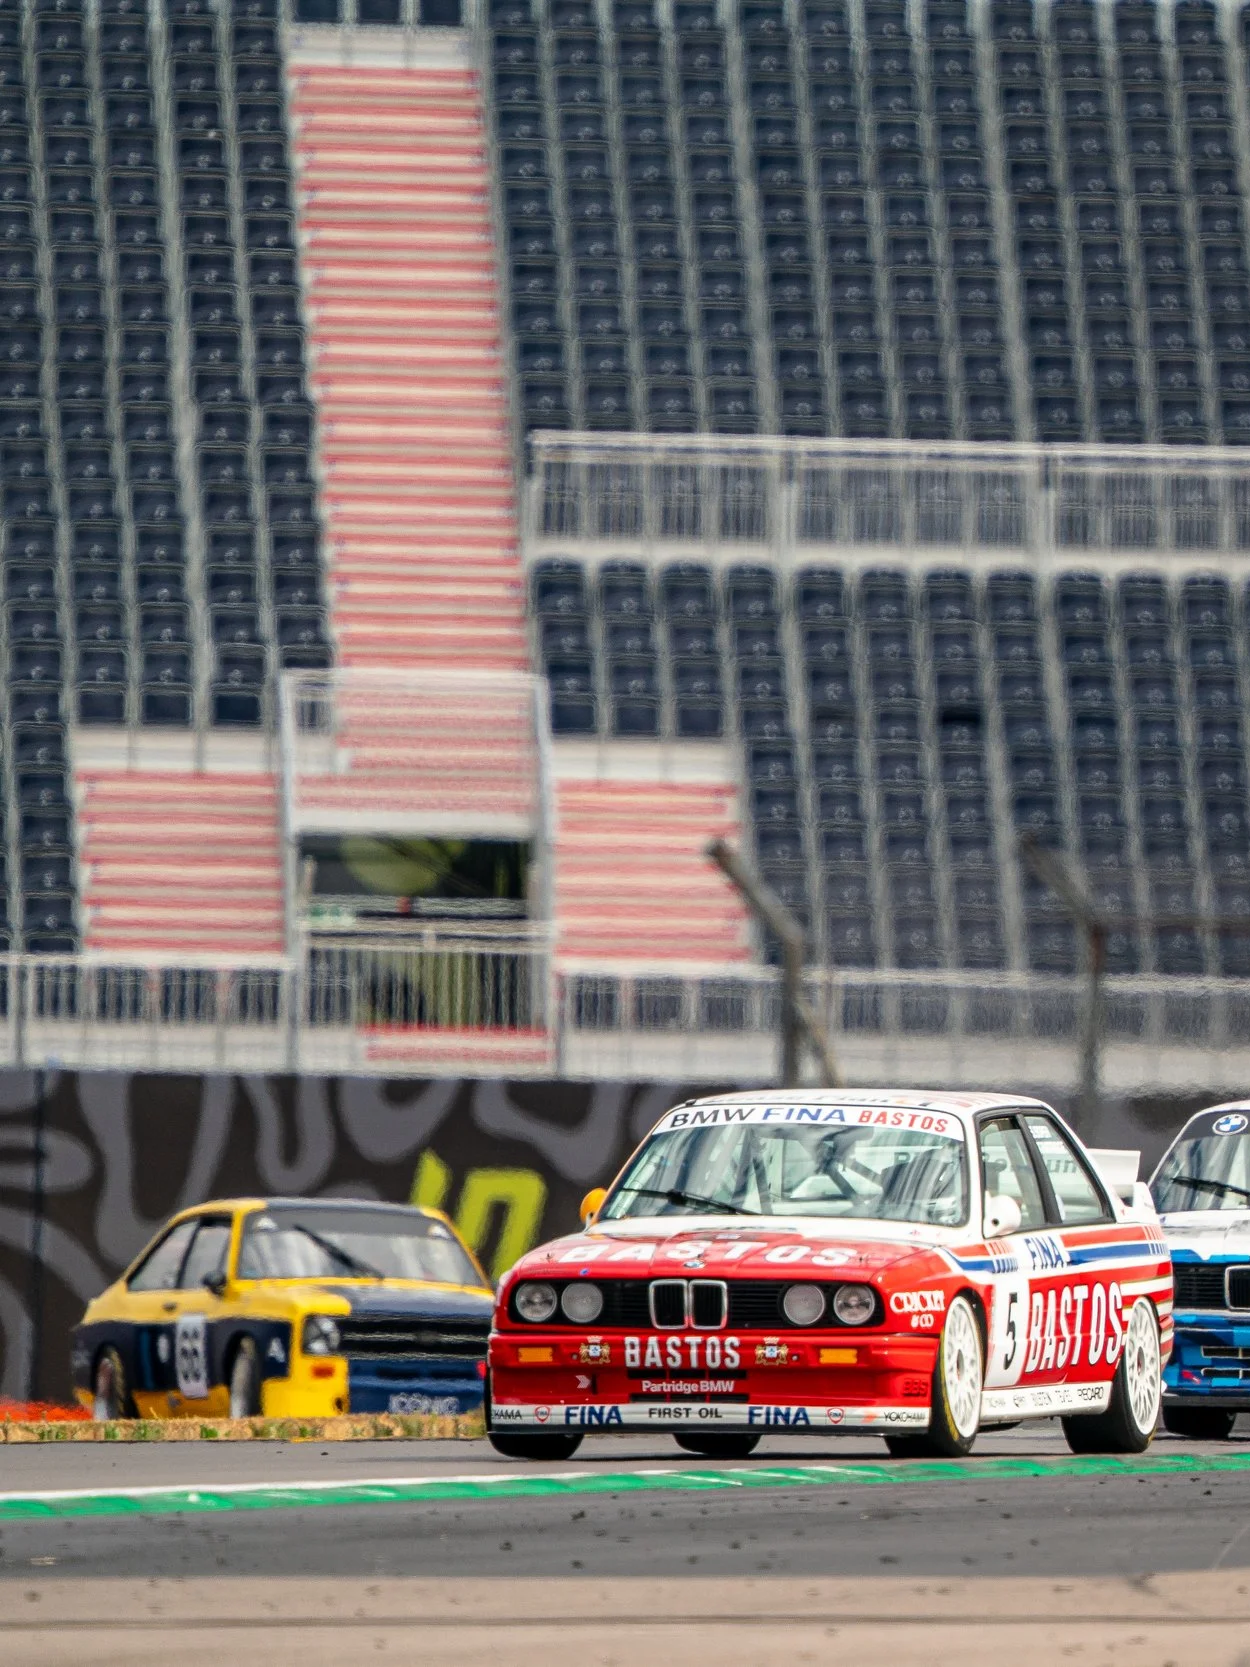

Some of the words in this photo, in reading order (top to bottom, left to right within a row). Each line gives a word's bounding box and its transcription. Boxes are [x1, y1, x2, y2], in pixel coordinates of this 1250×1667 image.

[670, 1107, 756, 1128] BMW
[762, 1107, 845, 1122] FINA
[858, 1110, 949, 1132] BASTOS
[558, 1239, 859, 1266] BASTOS
[1024, 1236, 1065, 1271] FINA
[1003, 1292, 1018, 1370] 5
[1024, 1281, 1123, 1373] BASTOS
[624, 1336, 740, 1369] BASTOS
[642, 1380, 699, 1394] Partridge
[700, 1380, 735, 1392] BMW
[564, 1405, 623, 1425] FINA
[648, 1407, 692, 1418] FIRST
[698, 1407, 722, 1418] OIL
[748, 1406, 811, 1426] FINA
